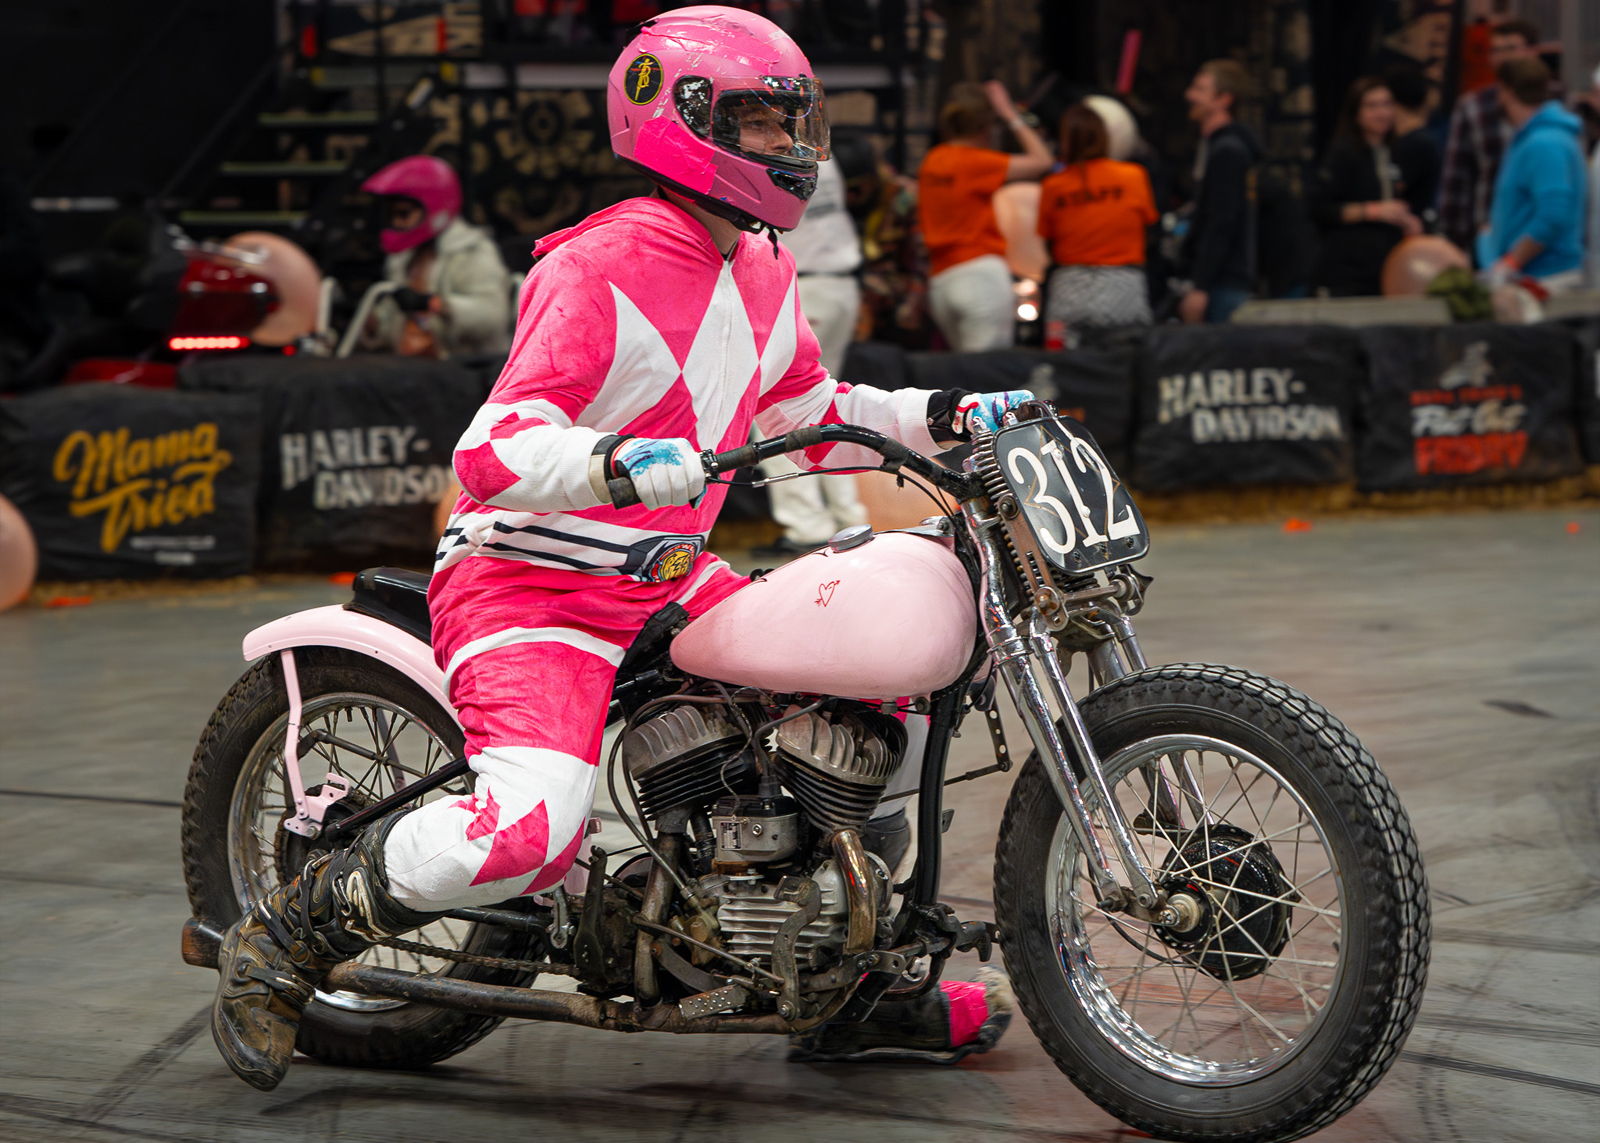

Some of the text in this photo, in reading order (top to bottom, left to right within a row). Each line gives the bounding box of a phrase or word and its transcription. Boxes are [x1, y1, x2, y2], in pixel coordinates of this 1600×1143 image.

[1157, 367, 1306, 424] HARLEY-
[1192, 404, 1344, 444] DAVIDSON
[53, 422, 218, 499] Mama
[281, 425, 430, 491] HARLEY-
[314, 464, 457, 510] DAVIDSO
[69, 450, 232, 553] Tried
[1007, 437, 1140, 553] 312
